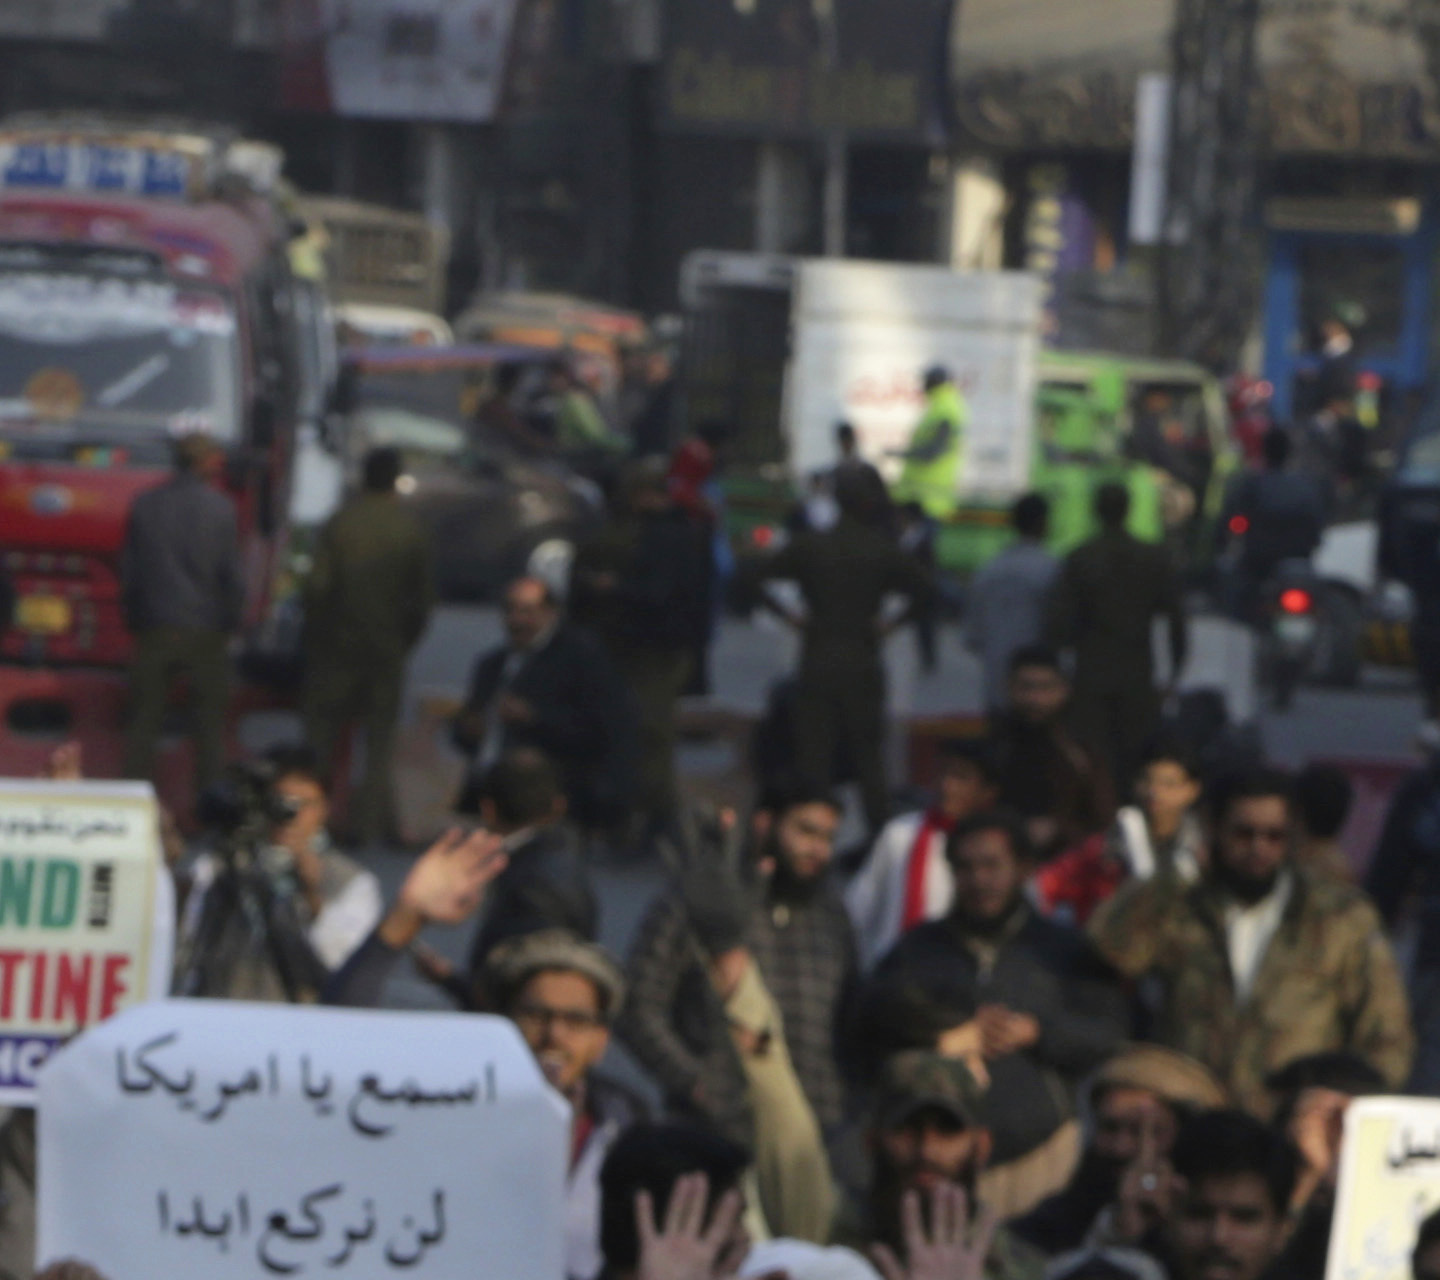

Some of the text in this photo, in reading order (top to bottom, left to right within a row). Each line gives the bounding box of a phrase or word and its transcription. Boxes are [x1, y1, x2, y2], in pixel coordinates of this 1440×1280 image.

[347, 1060, 499, 1138] اسمع
[156, 1190, 252, 1256] ابدا
[384, 1184, 449, 1268] لن
